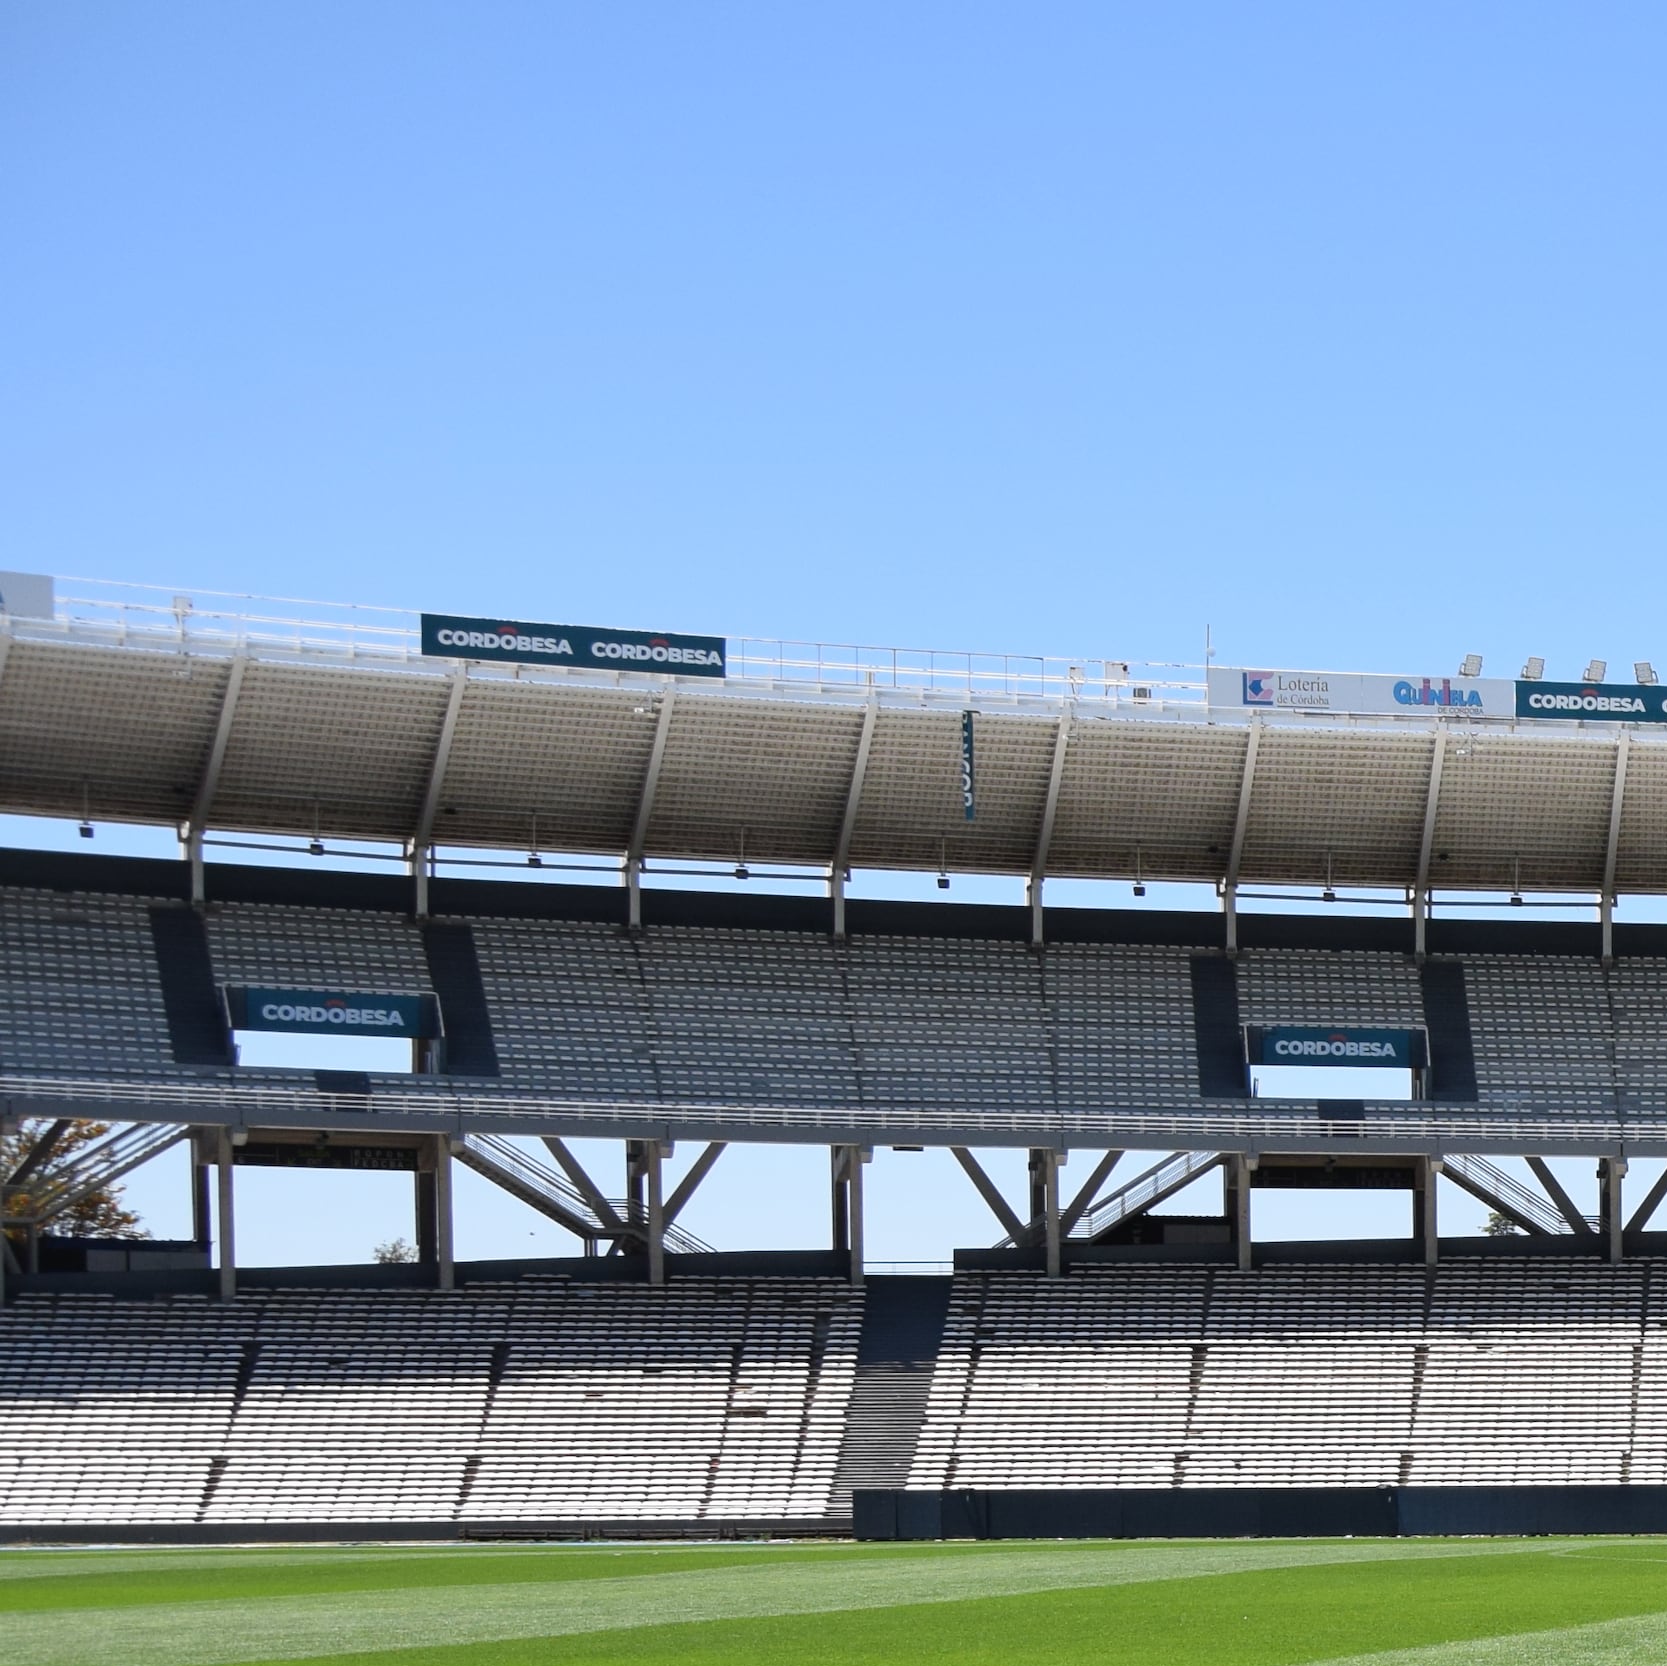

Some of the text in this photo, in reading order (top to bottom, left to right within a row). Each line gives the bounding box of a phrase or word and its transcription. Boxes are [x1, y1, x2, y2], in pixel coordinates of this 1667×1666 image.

[437, 629, 723, 666] CORDOBESA CORDOBESA
[1528, 692, 1646, 714] CORDOBESA
[261, 1003, 405, 1028] CORDOBESA
[1274, 1039, 1397, 1058] CORDOBESA
